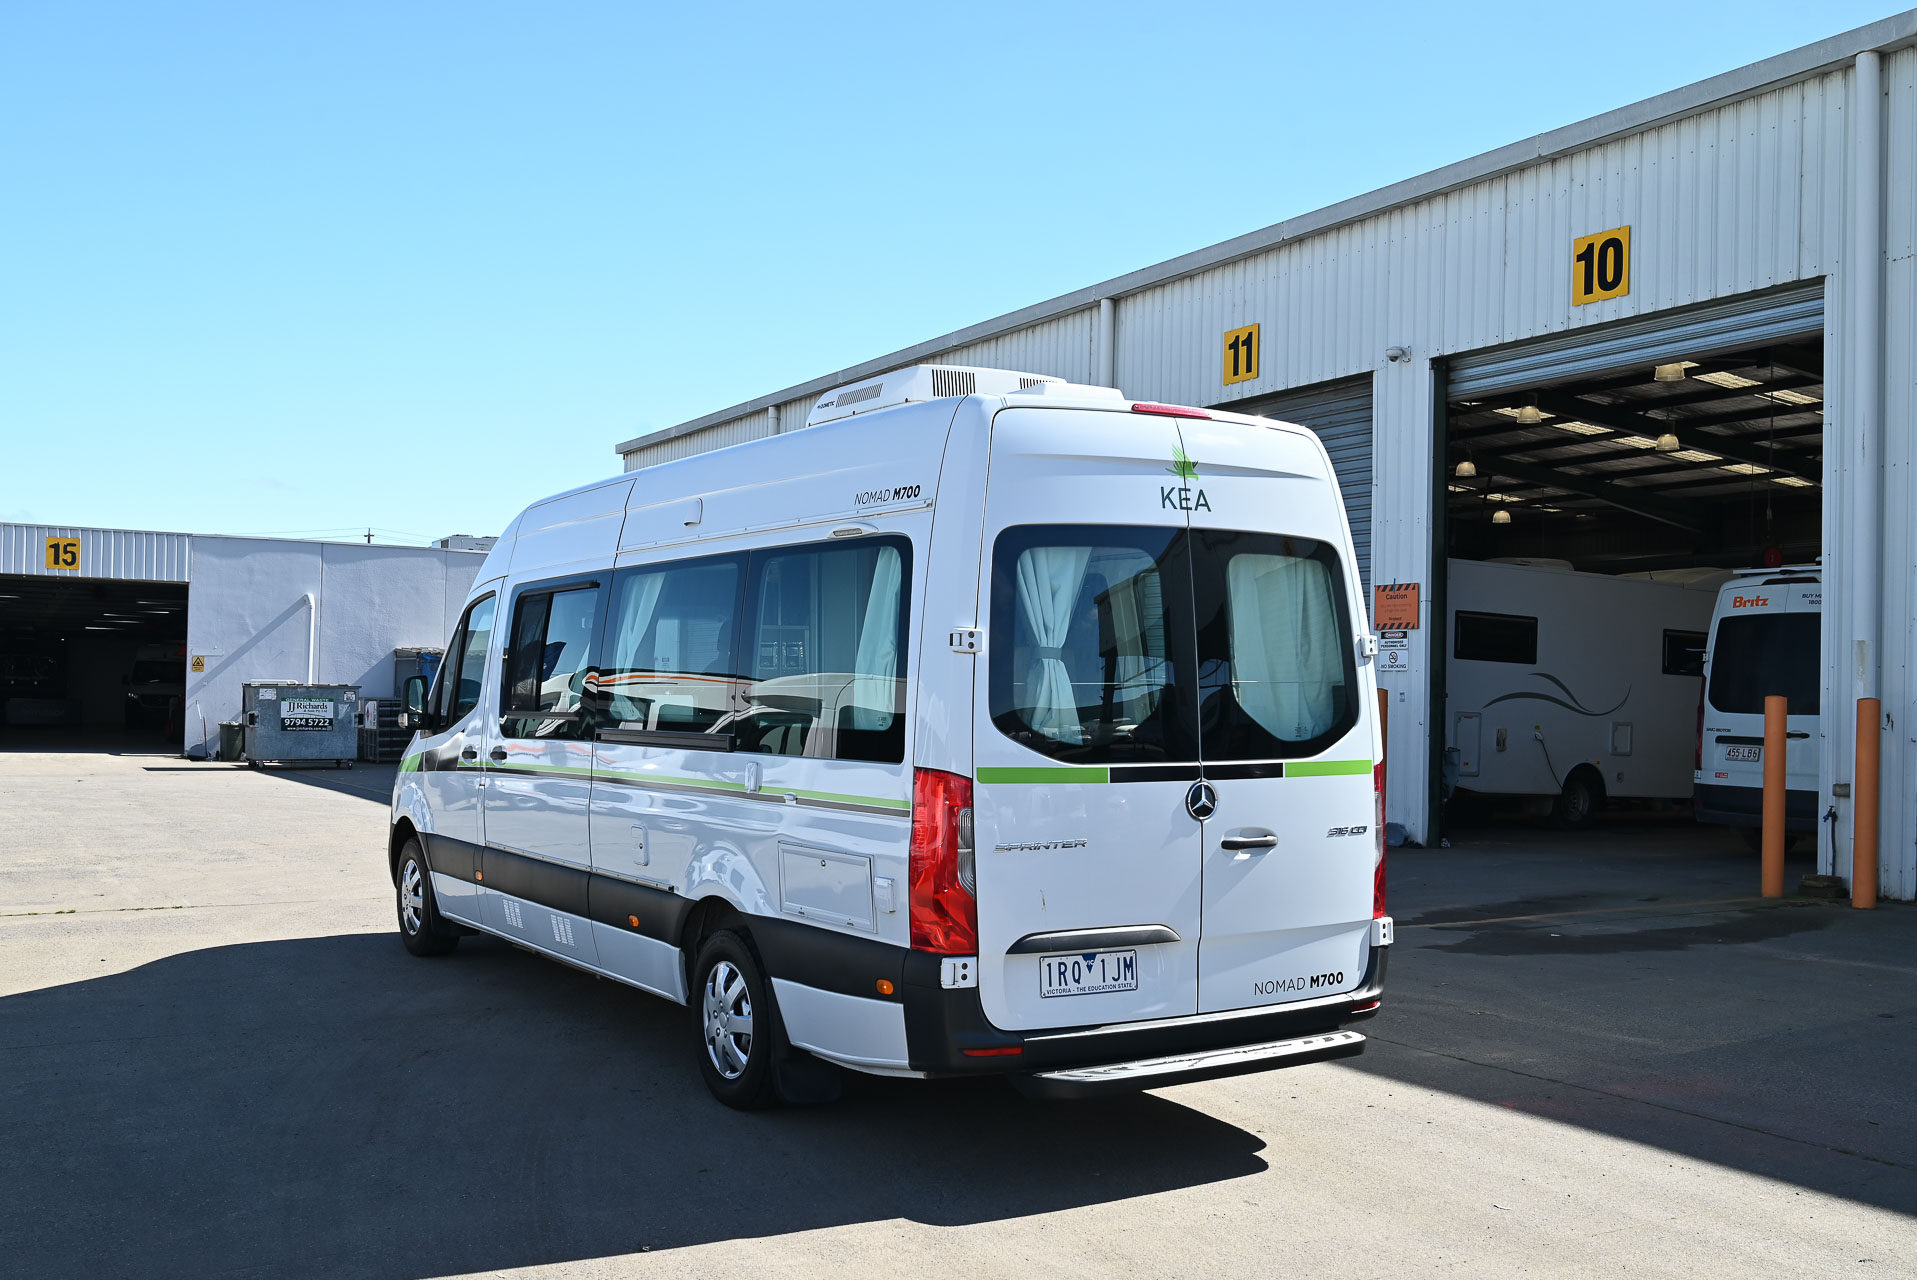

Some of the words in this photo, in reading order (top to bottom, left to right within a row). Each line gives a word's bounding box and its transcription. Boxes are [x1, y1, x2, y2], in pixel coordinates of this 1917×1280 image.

[1576, 237, 1624, 296] 10
[1228, 331, 1253, 377] 11
[854, 488, 891, 506] NOMAD
[892, 484, 921, 501] M700
[1160, 486, 1212, 513] KEA
[49, 541, 77, 567] 15
[1385, 592, 1408, 600] Caution
[1733, 595, 1770, 609] Britz
[287, 702, 295, 713] JJ
[296, 702, 328, 710] Richards
[284, 718, 306, 726] 9794
[308, 718, 330, 726] 5722
[1327, 826, 1349, 836] 316
[994, 838, 1088, 853] SPRINTER
[1046, 960, 1082, 988] 1RQ
[1100, 955, 1135, 984] 1JM
[1046, 987, 1072, 996] VICTORIA
[1087, 983, 1117, 992] EDUCATION
[1254, 977, 1306, 996] NOMAD
[1309, 971, 1344, 989] M700
